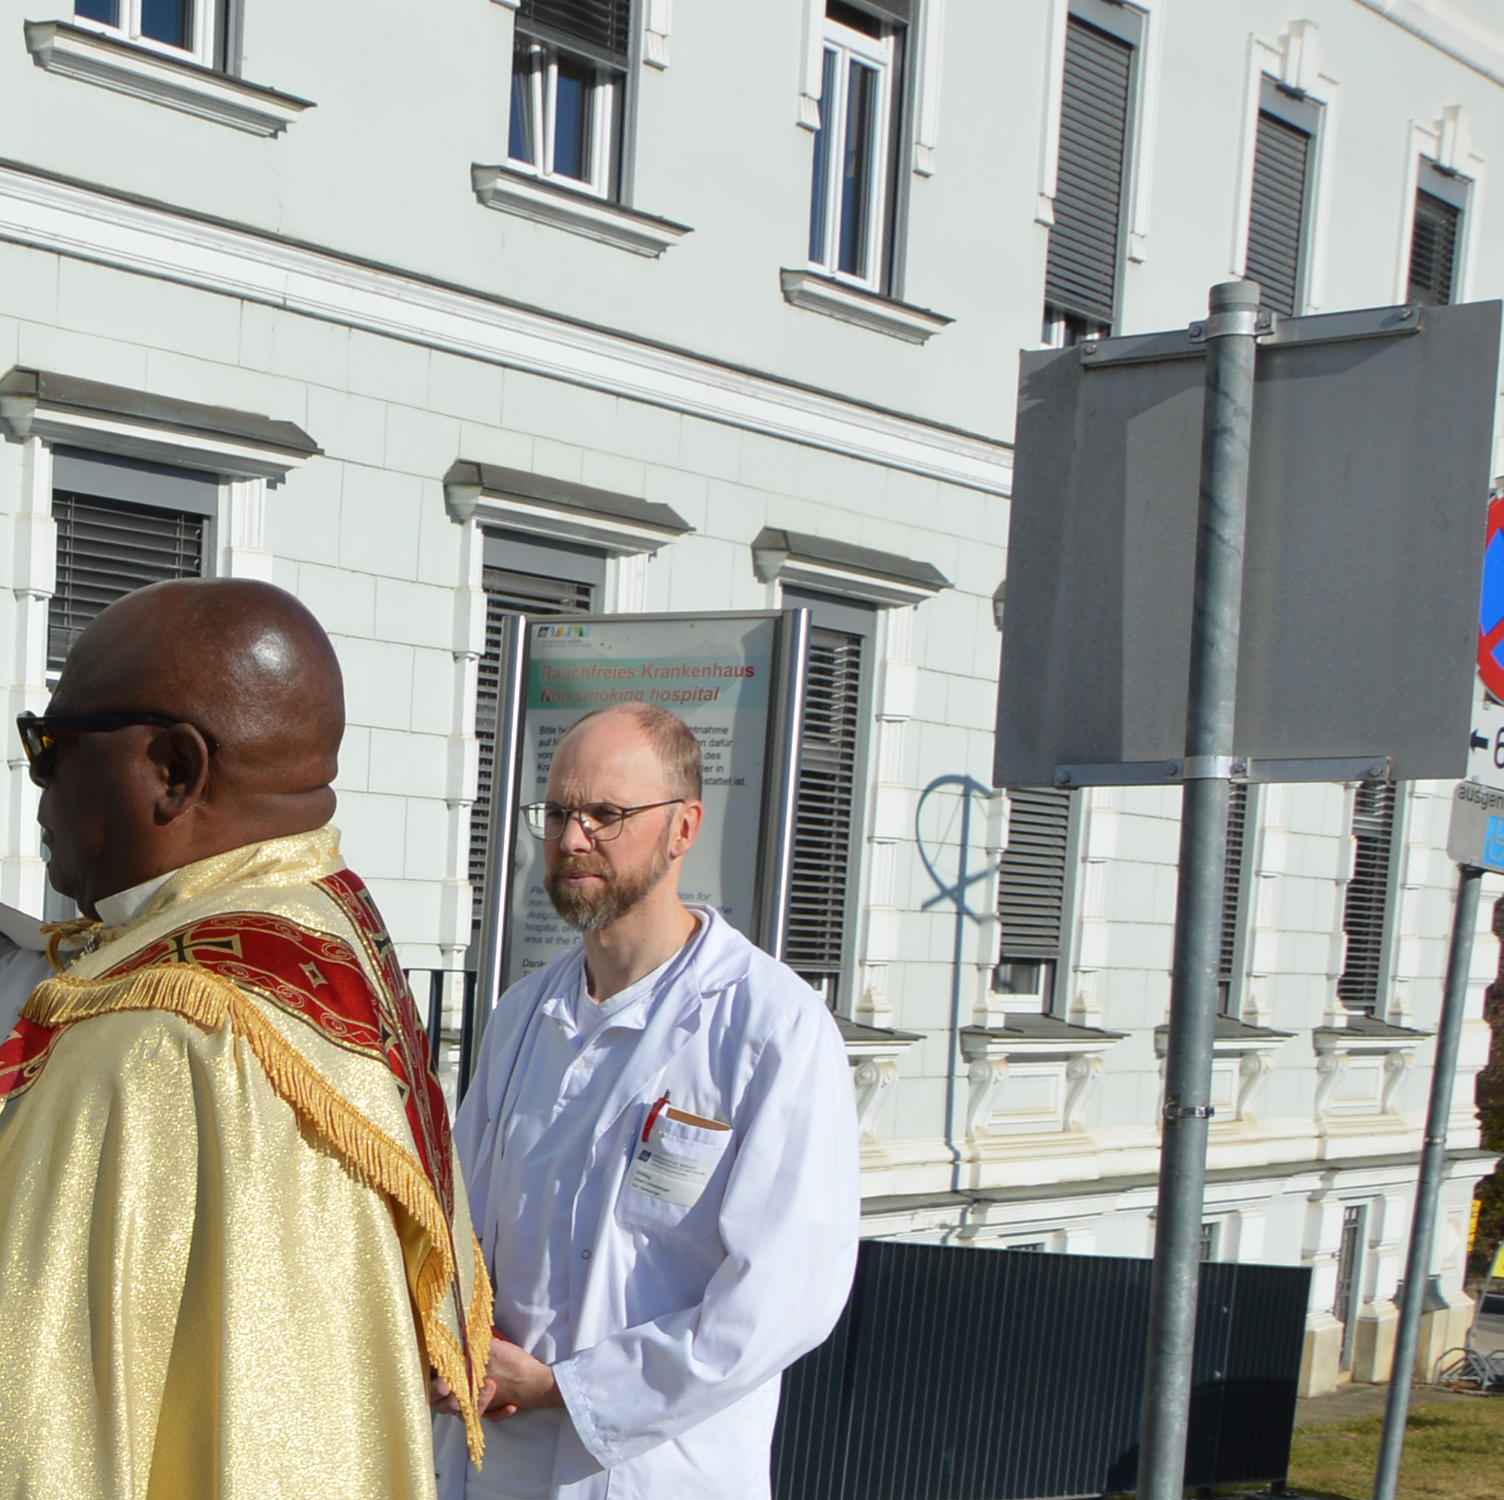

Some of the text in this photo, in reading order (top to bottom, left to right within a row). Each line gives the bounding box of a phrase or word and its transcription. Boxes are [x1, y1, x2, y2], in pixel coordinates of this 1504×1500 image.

[541, 663, 755, 681] Rauchfreies Krankenhaus
[575, 687, 644, 703] smoking
[650, 686, 720, 705] hospital
